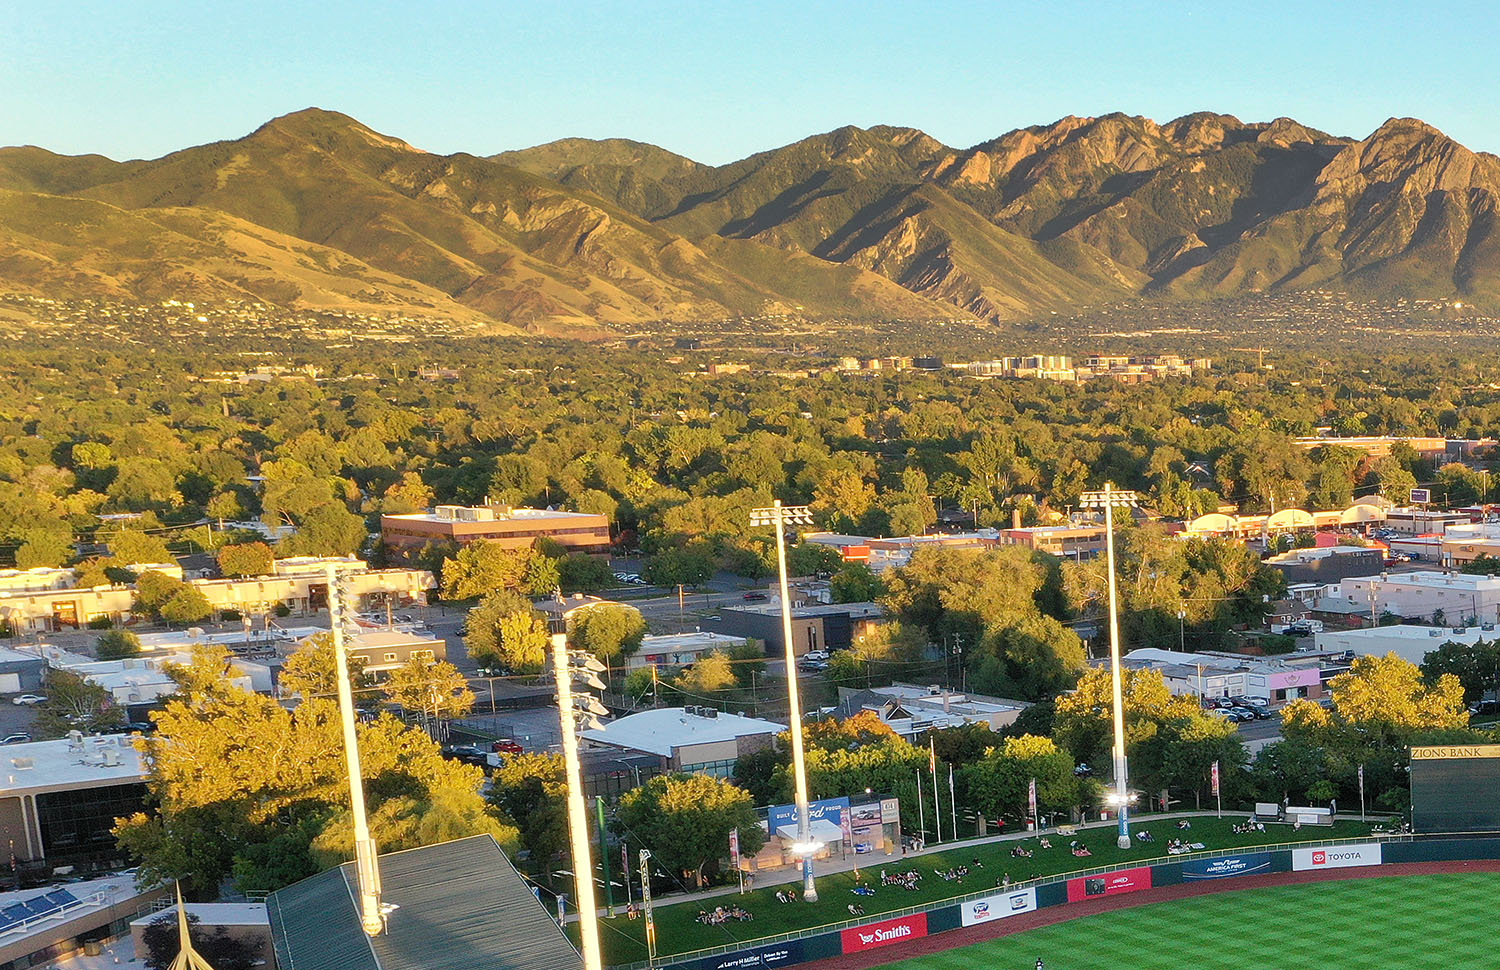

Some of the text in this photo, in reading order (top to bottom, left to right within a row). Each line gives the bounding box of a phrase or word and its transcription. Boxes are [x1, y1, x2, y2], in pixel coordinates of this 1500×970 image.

[1412, 748, 1447, 758] ZIONS
[1450, 747, 1481, 757] BANK
[1328, 852, 1361, 861] TOYOTA
[1207, 865, 1231, 873] AMERICA
[875, 924, 911, 942] Smith's
